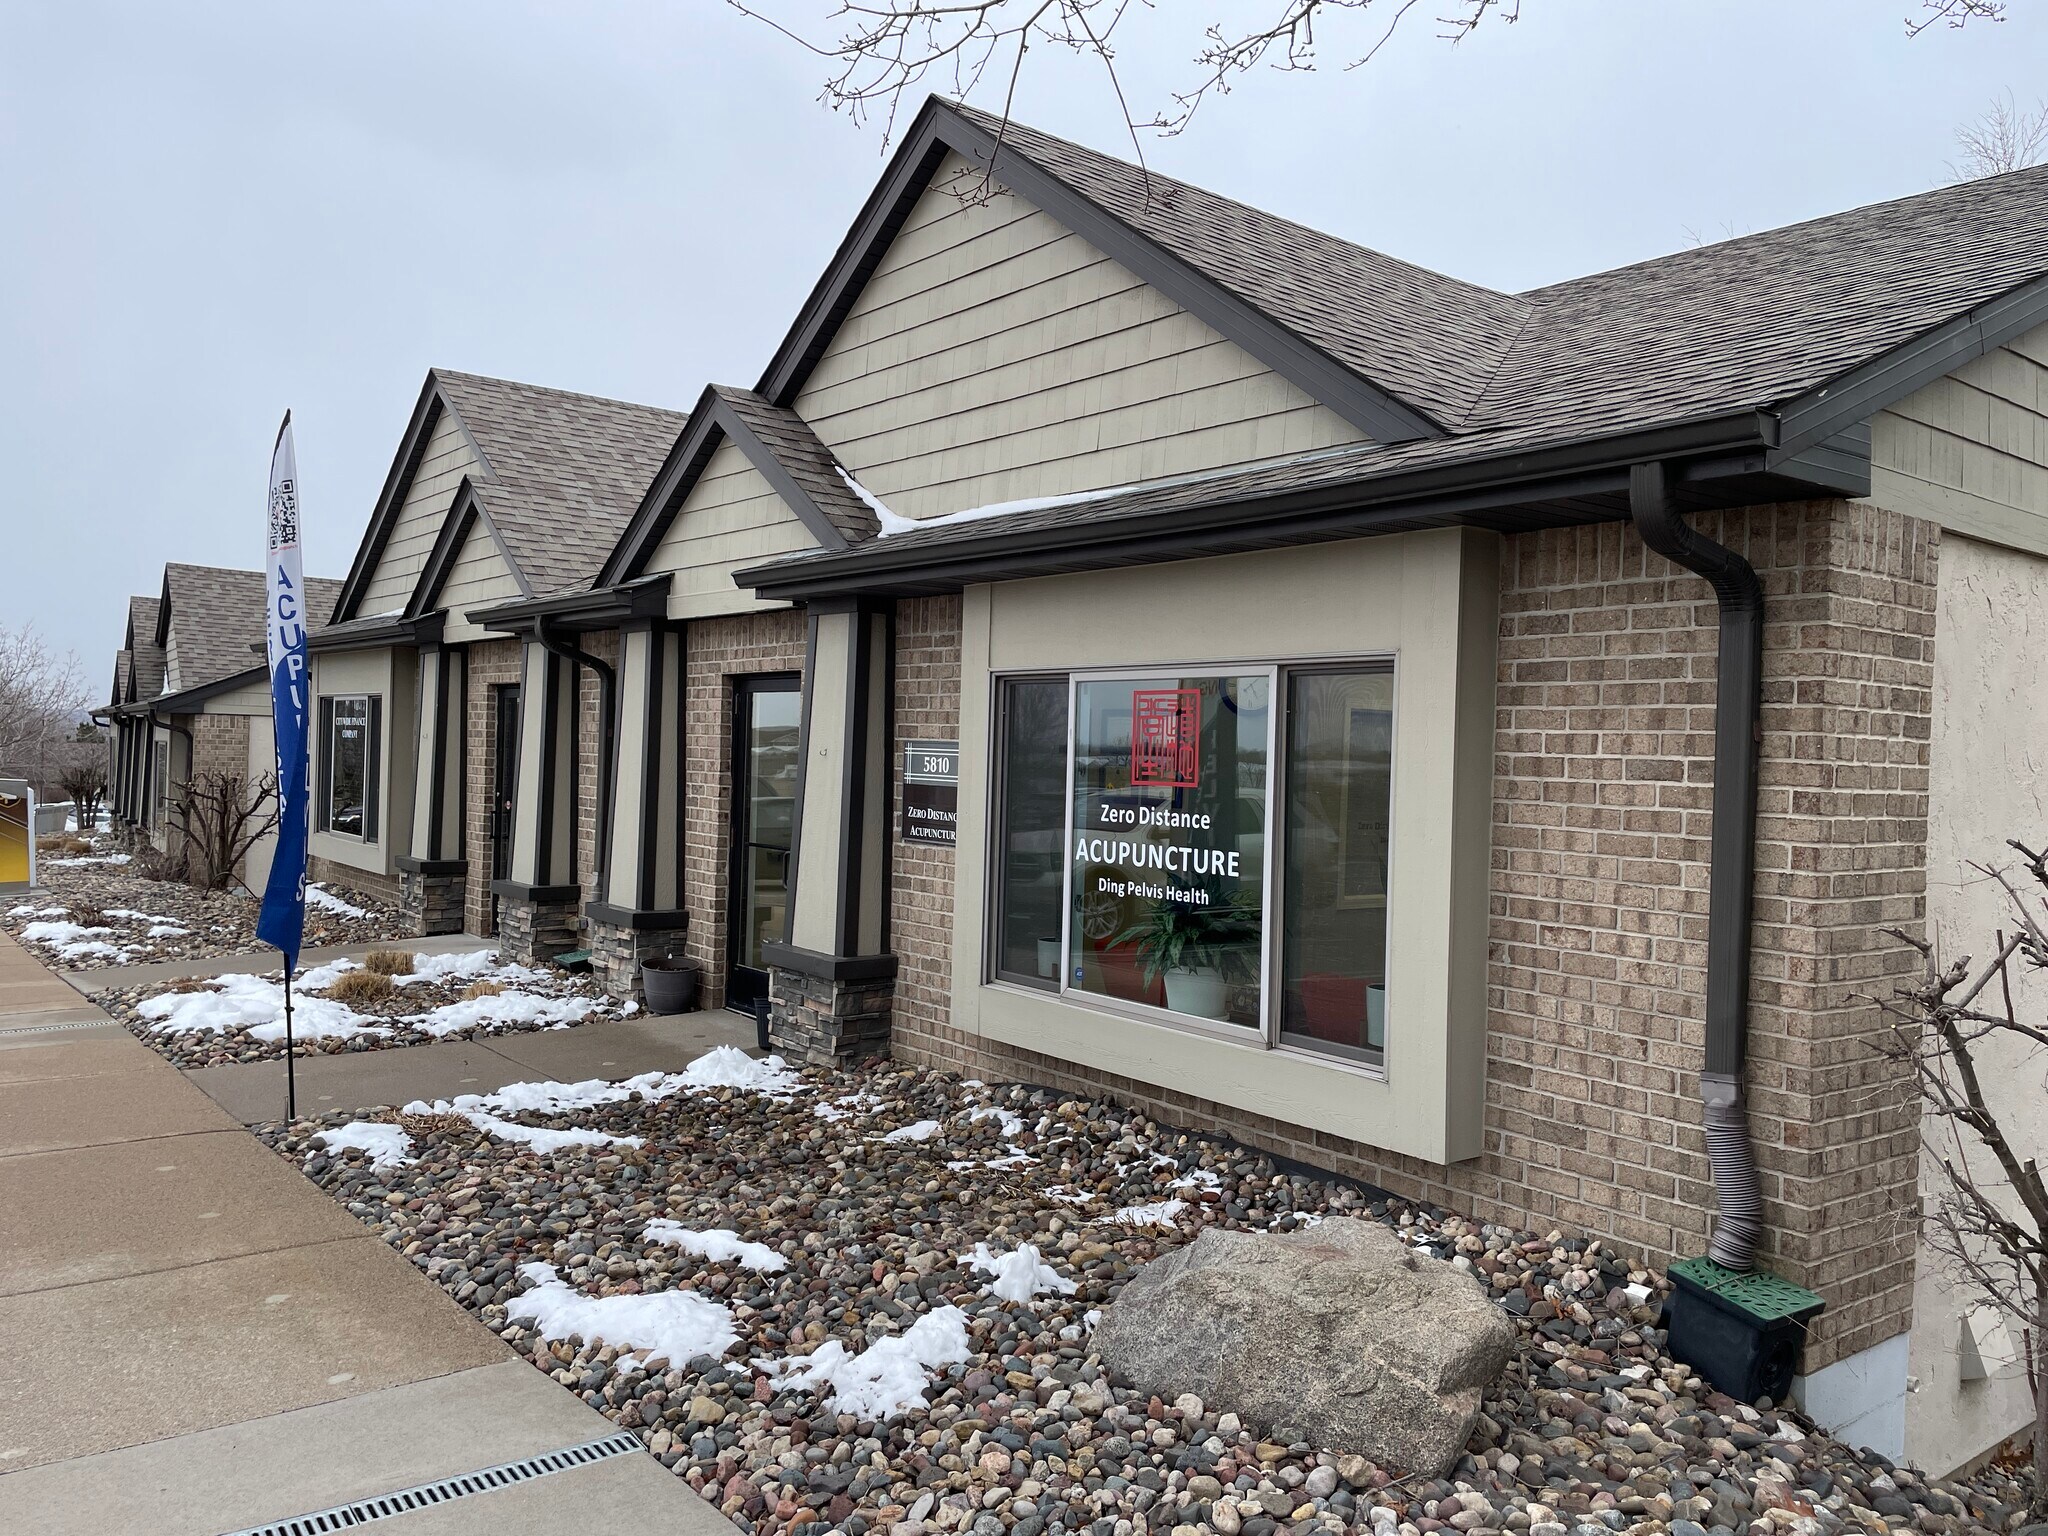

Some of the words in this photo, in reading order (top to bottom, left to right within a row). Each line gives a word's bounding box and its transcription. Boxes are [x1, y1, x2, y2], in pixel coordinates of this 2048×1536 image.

[923, 756, 950, 773] 5810
[927, 808, 957, 822] DISTANC
[1100, 804, 1135, 824] Zero
[1139, 806, 1211, 829] Distance
[910, 825, 956, 840] ACUPUNCTUR
[1075, 838, 1240, 878] ACUPUNCTURE
[1098, 877, 1125, 898] Ding
[1127, 881, 1163, 900] Pelvis
[1166, 885, 1209, 906] Health
